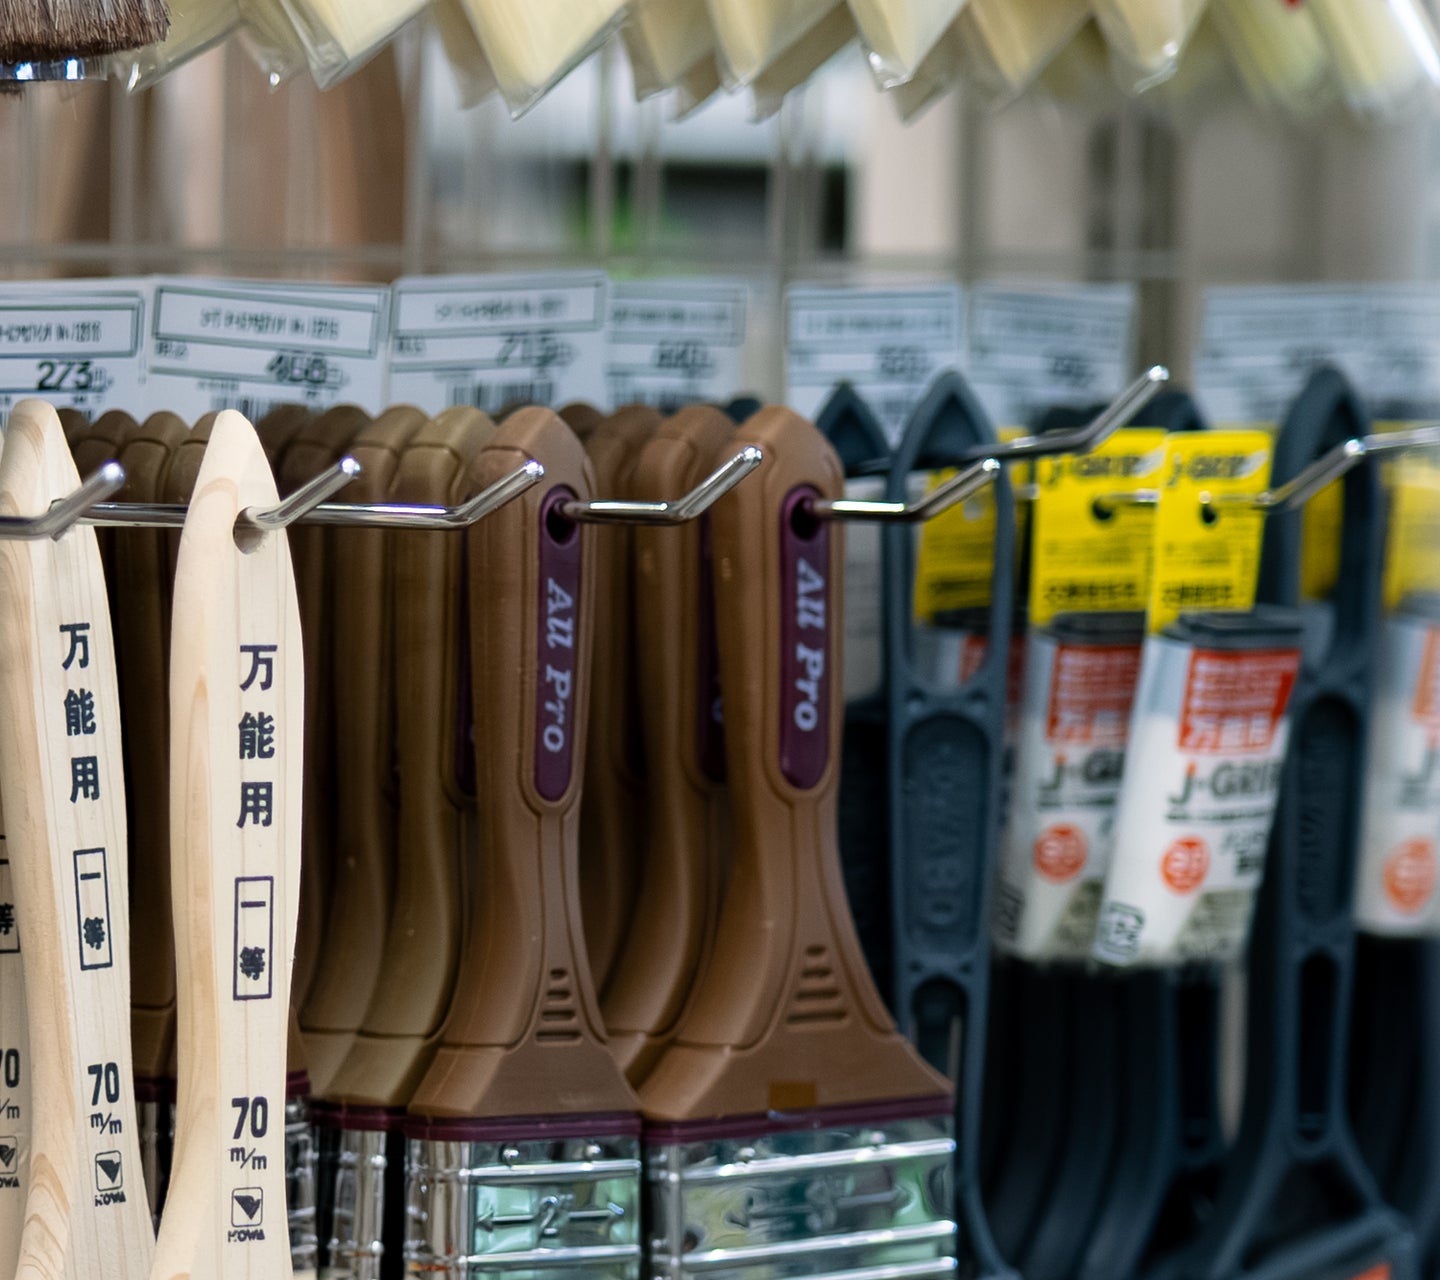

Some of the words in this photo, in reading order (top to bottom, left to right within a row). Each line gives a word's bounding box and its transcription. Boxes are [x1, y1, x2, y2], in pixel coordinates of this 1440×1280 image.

[546, 577, 574, 651] All
[797, 558, 828, 632] All
[59, 622, 101, 805] 万能用
[542, 663, 573, 756] Pro
[791, 642, 826, 734] Pro
[236, 644, 278, 830] 万能用
[79, 870, 107, 952] 一等
[239, 898, 268, 983] 一等
[87, 1061, 121, 1107] 70
[230, 1095, 268, 1141] 70
